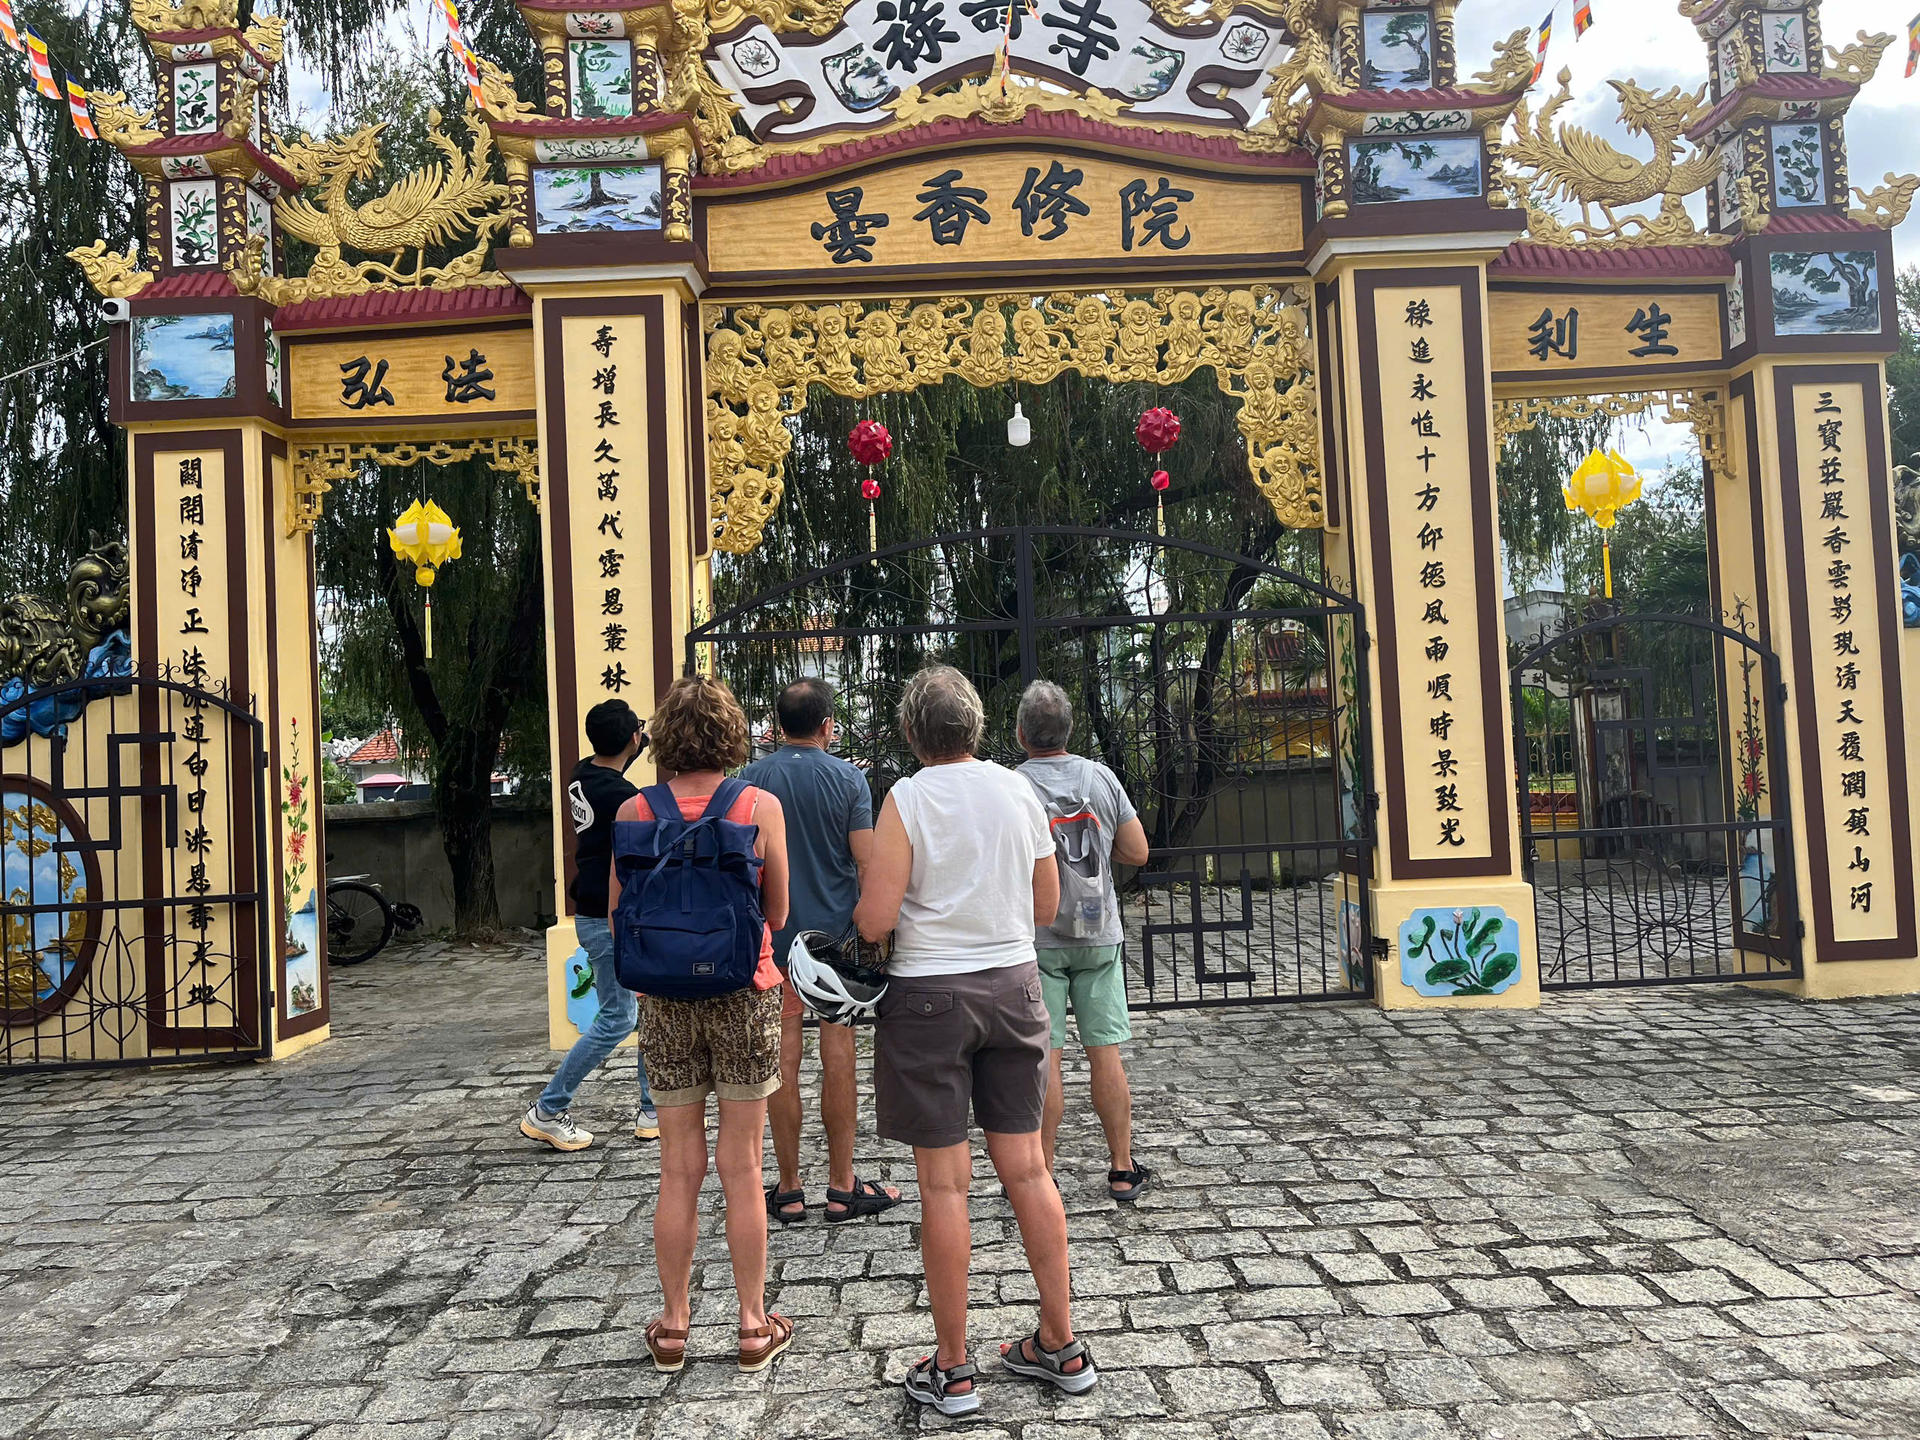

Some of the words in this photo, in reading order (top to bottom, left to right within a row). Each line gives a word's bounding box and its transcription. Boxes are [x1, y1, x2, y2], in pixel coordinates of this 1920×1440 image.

[810, 160, 1195, 263] 曇香修院
[1528, 302, 1679, 361] 利生
[338, 348, 496, 410] 弘法
